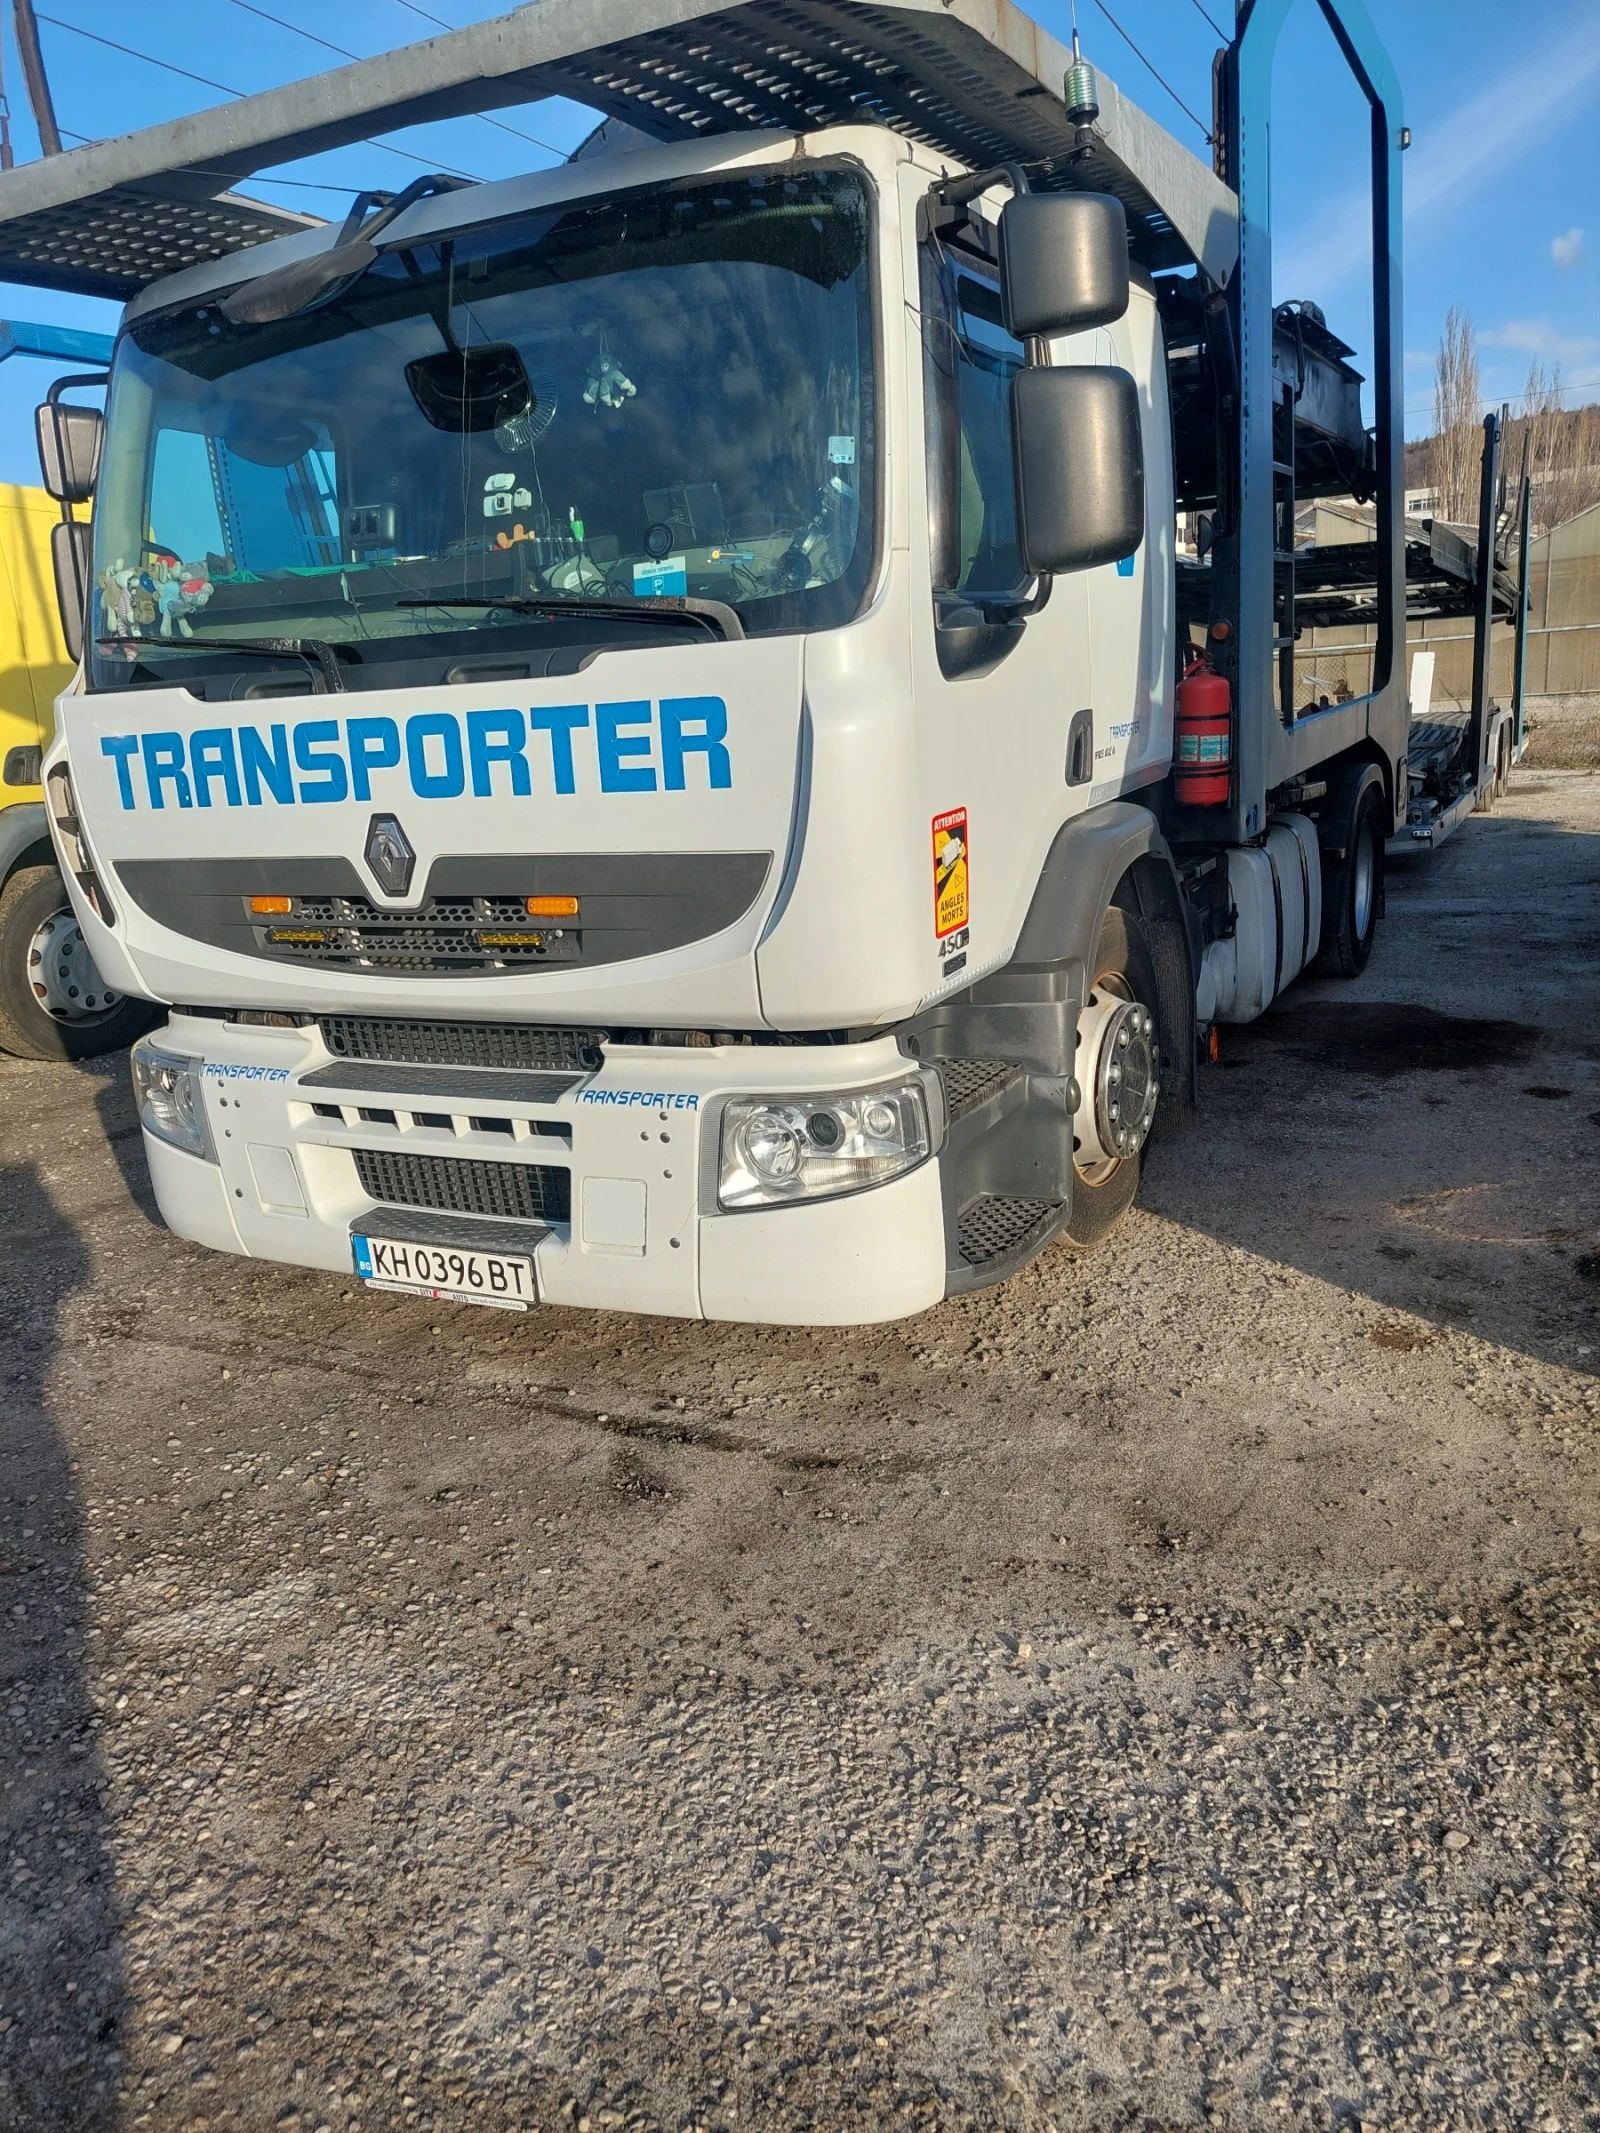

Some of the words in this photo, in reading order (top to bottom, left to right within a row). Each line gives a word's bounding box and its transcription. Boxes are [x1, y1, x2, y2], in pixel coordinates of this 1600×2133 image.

[100, 695, 733, 810] TRANSPORTER
[934, 810, 965, 831] ATTENTION
[940, 892, 965, 913] ANGLES
[941, 905, 964, 926] MORTS
[938, 931, 964, 958] 450
[201, 1063, 291, 1083] TRANSPORTER
[575, 1089, 699, 1111] TRANSPORTER
[359, 1260, 372, 1271] BG
